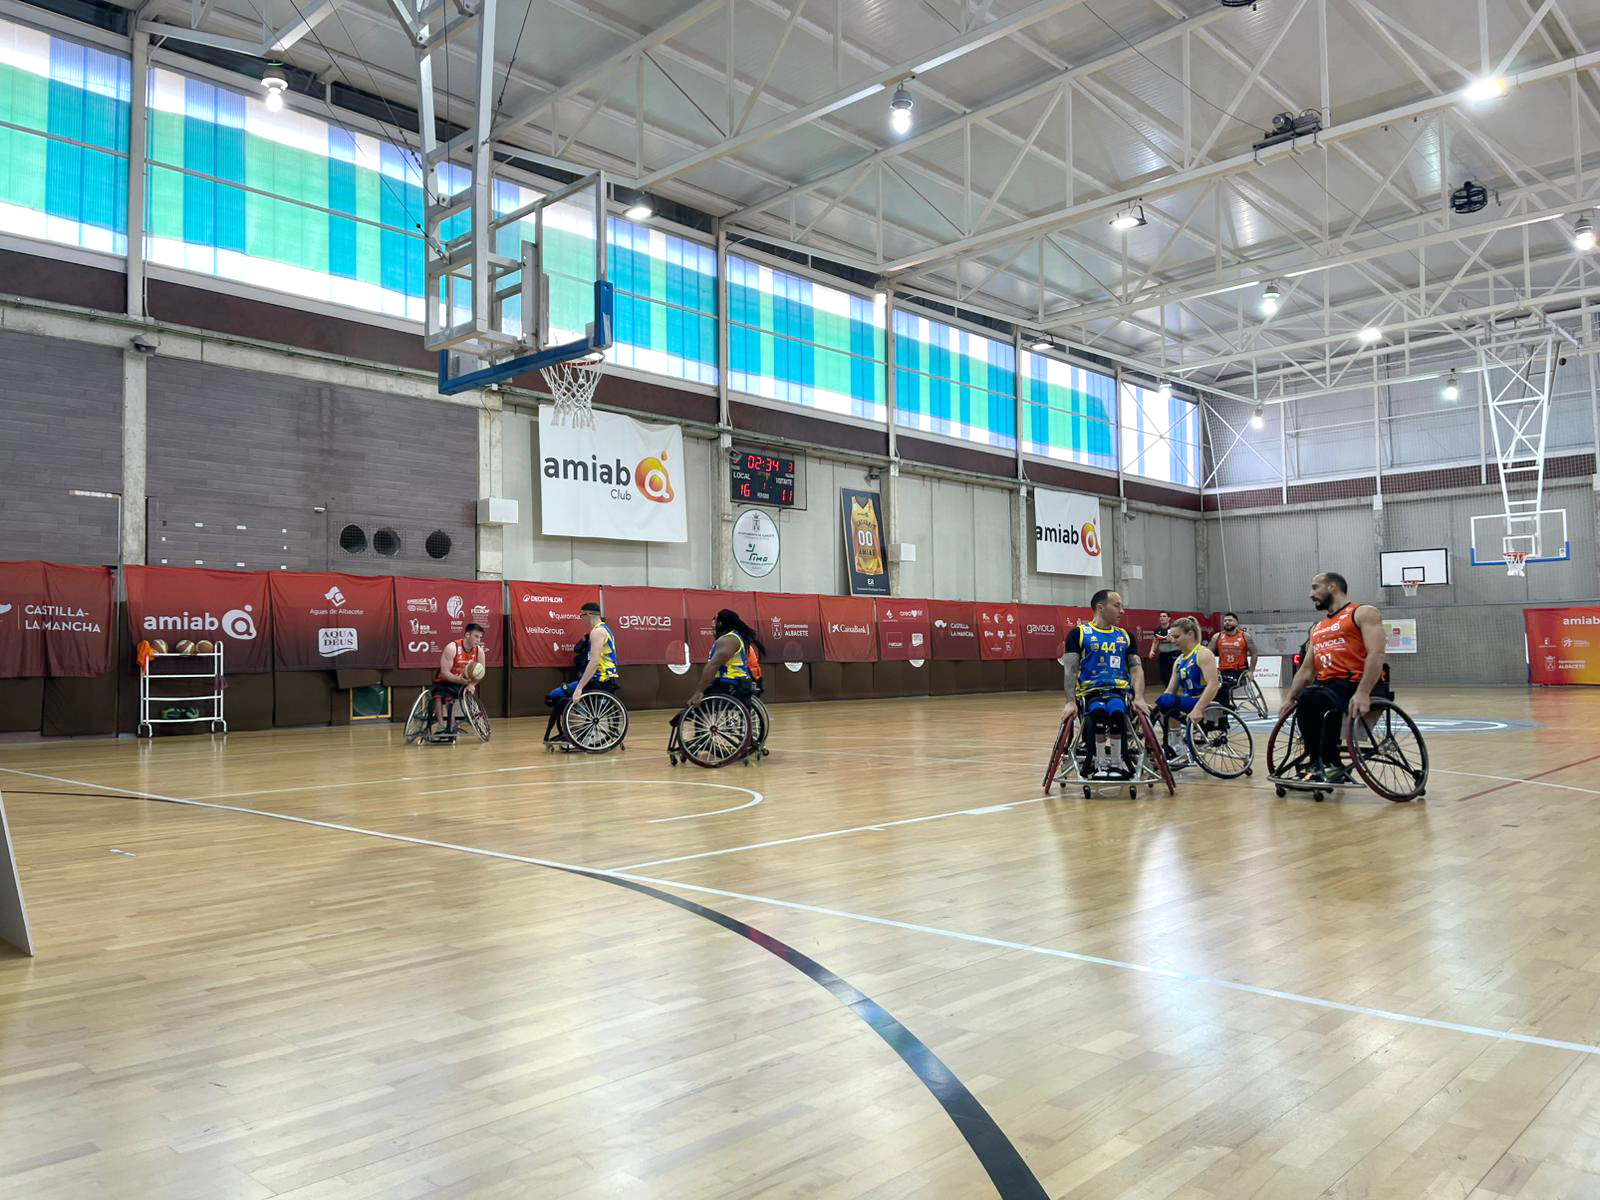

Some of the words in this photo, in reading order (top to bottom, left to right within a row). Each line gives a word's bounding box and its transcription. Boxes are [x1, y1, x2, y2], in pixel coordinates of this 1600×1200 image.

[544, 454, 631, 486] amiab
[747, 455, 781, 473] 02:34
[733, 472, 751, 480] LOCAL
[610, 489, 632, 501] Club
[740, 483, 751, 497] 16
[782, 489, 793, 502] 11
[858, 530, 873, 547] 00
[1036, 523, 1080, 545] amiab
[530, 595, 563, 604] DECATHLON
[24, 619, 42, 631] LA
[42, 620, 102, 633] MANCHA
[144, 611, 219, 631] amiab
[619, 615, 672, 629] gaviota
[1562, 615, 1600, 625] amiab
[322, 630, 354, 639] AQUA
[784, 630, 809, 638] ALBACETE
[1026, 623, 1056, 634] gaviota
[324, 638, 354, 647] DEUS
[1101, 641, 1117, 654] 44
